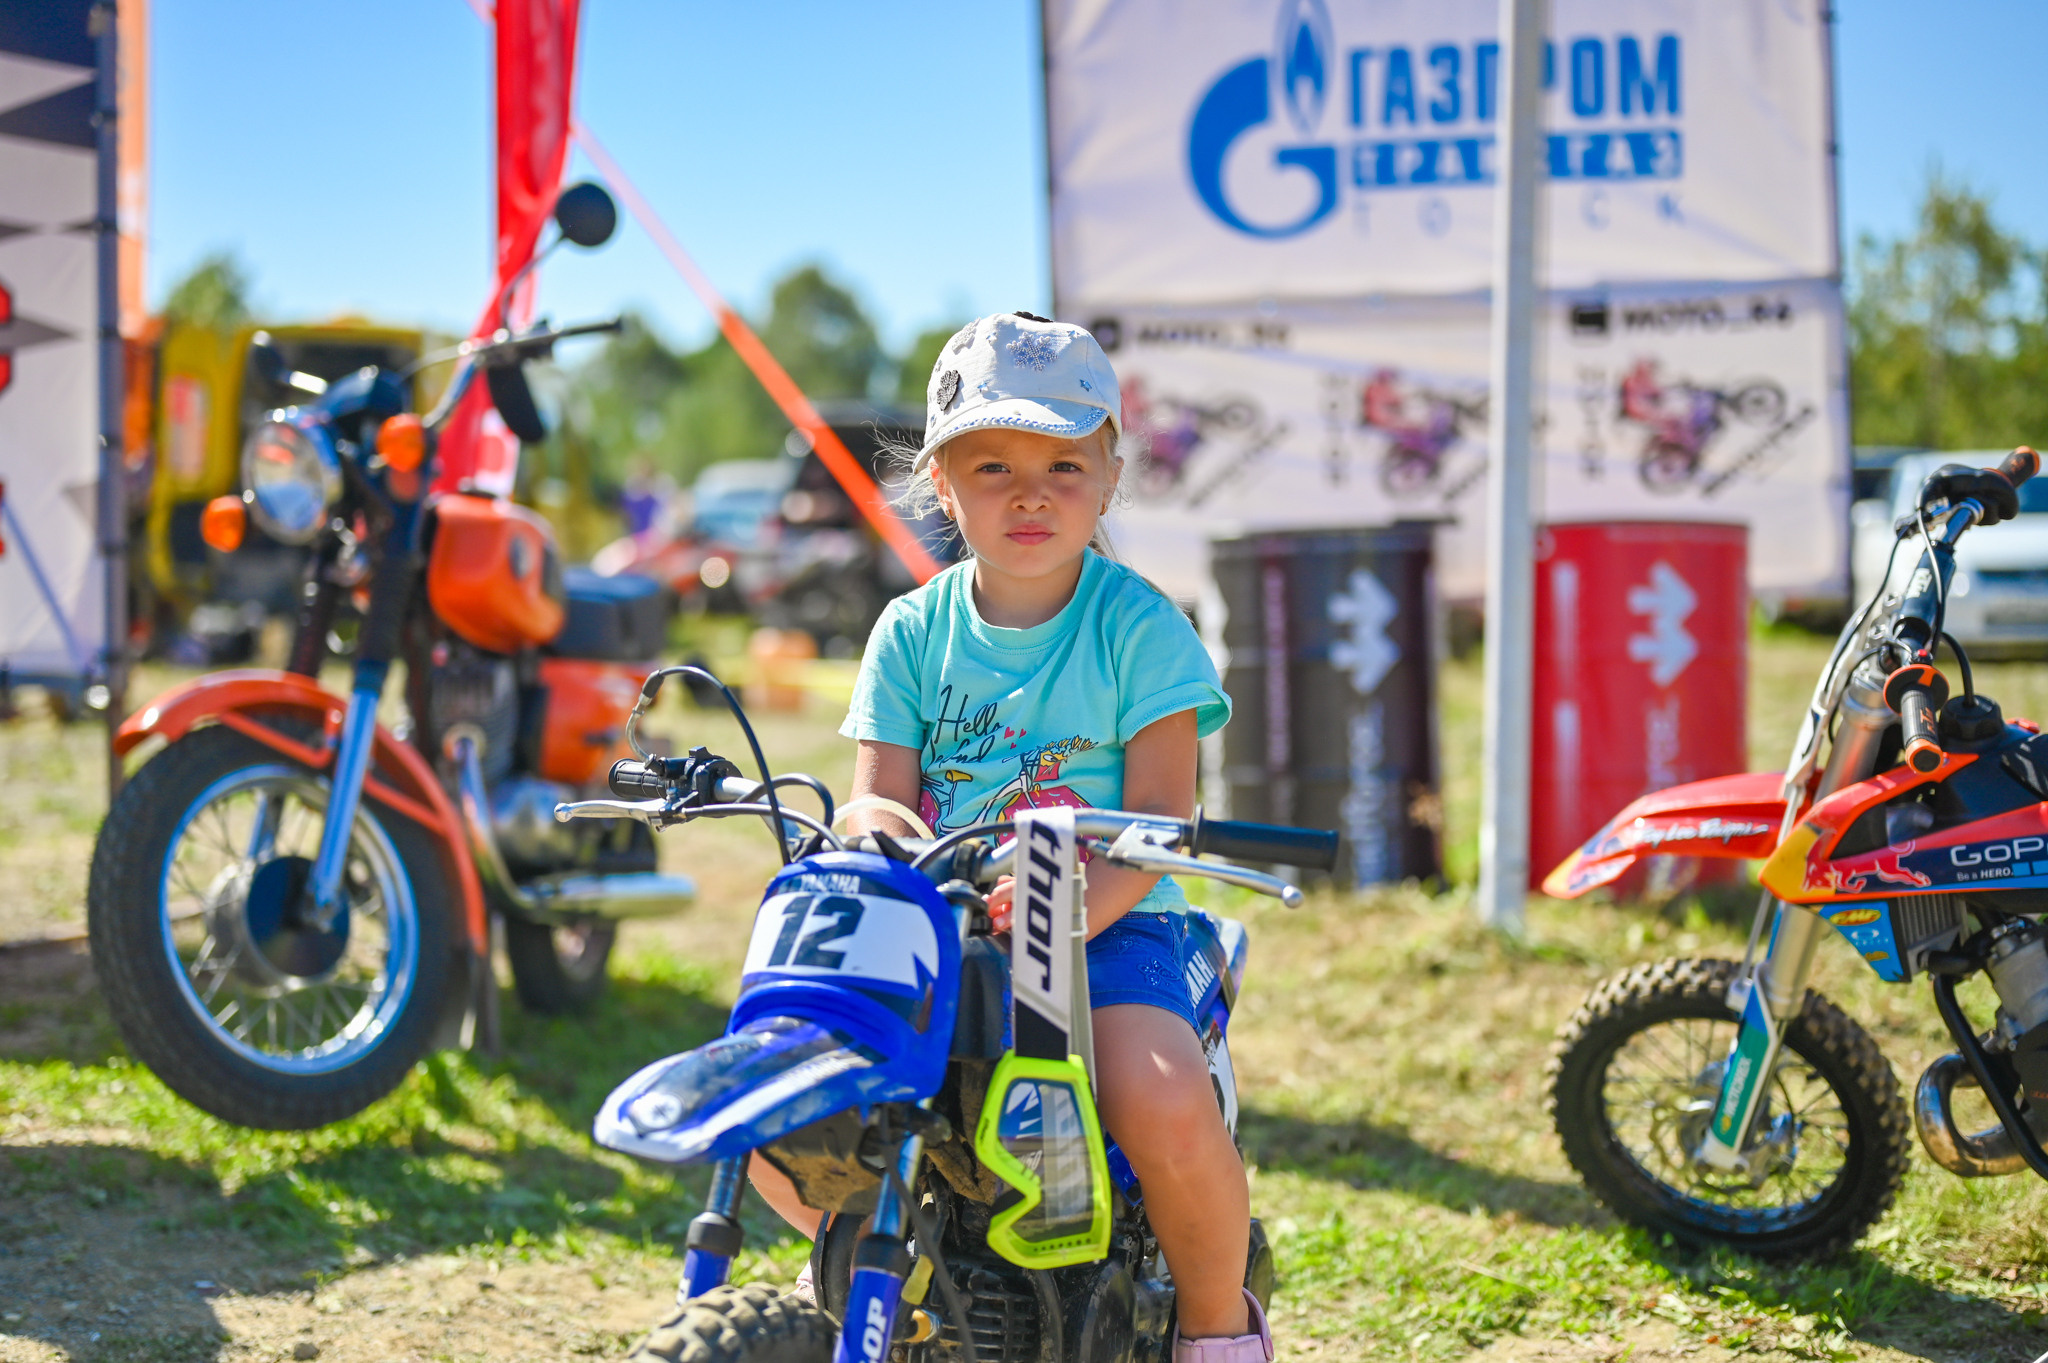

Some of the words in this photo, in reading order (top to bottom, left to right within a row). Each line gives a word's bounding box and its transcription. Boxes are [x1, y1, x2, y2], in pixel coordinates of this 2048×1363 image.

[1354, 131, 1682, 187] ТРАГАЗ
[1353, 189, 1687, 240] ТОСК
[934, 684, 1005, 745] Hello
[1950, 836, 2048, 867] GoP
[800, 873, 862, 895] YAMAHA
[1028, 819, 1063, 993] thor
[767, 894, 866, 971] 12
